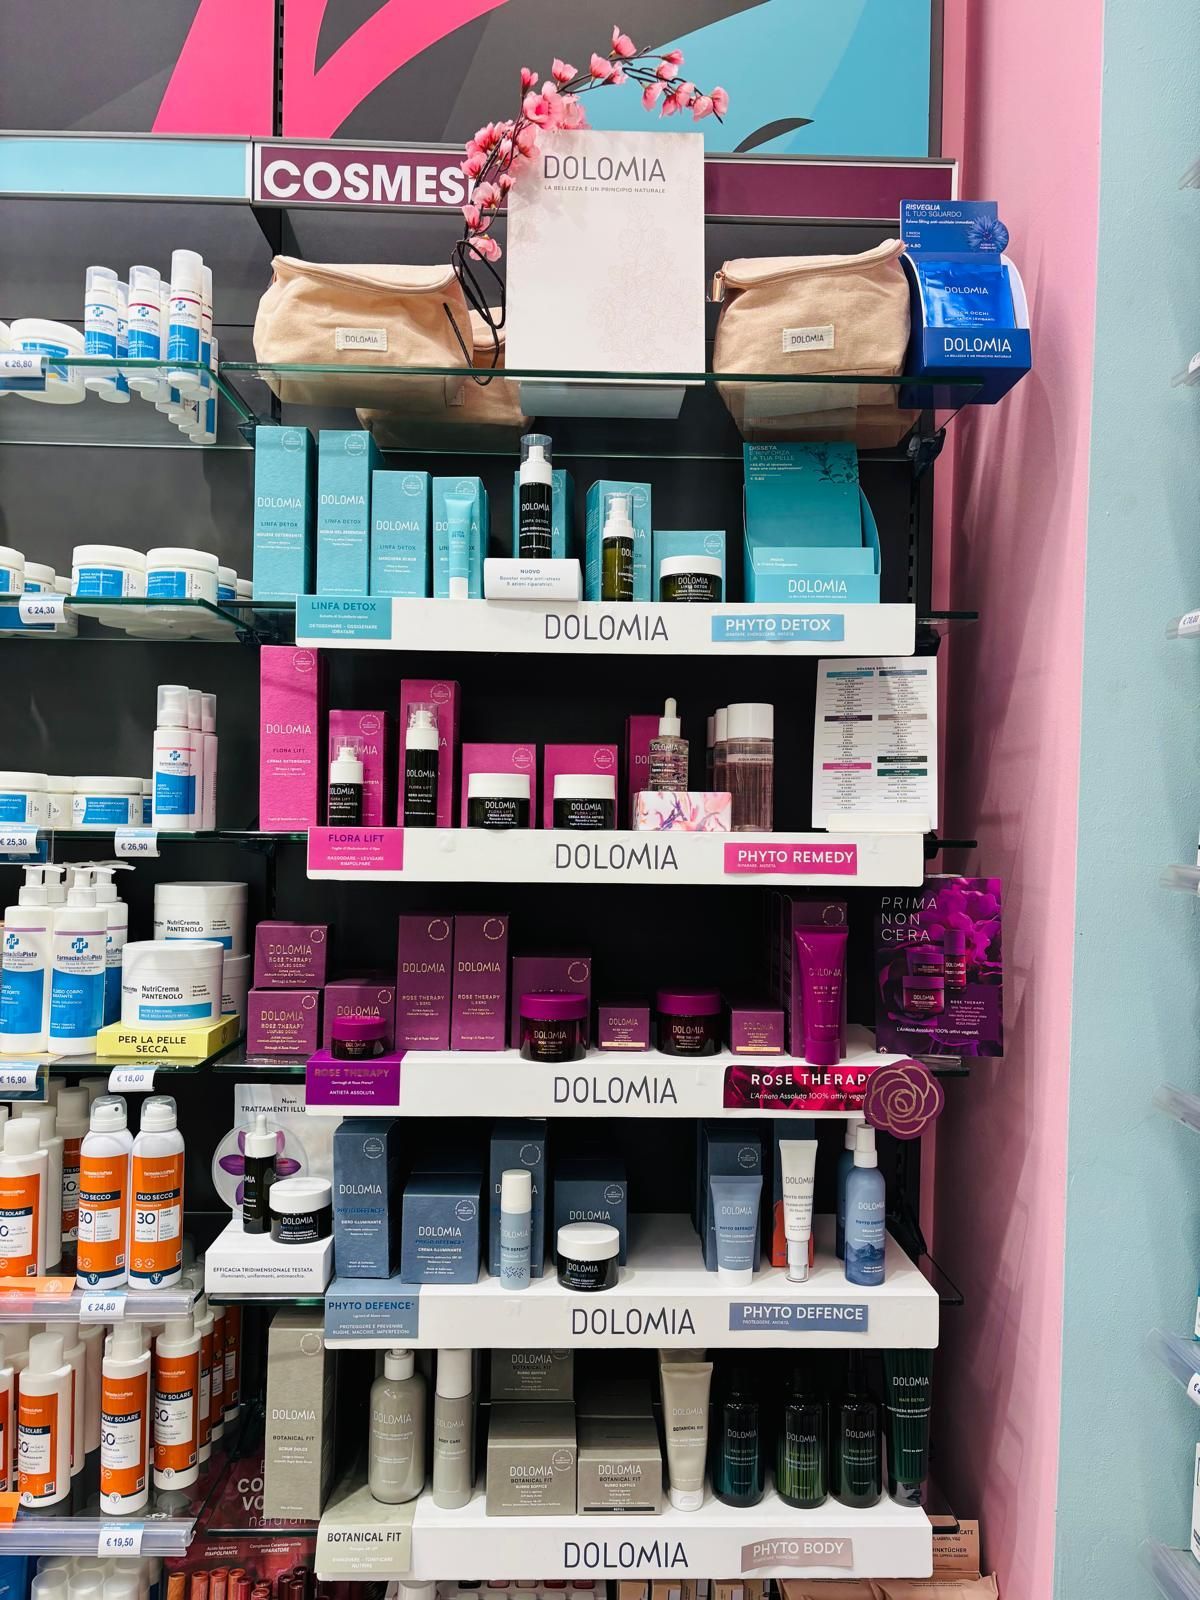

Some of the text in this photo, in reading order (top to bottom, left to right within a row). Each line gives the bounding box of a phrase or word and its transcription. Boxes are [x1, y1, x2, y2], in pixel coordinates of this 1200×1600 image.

[544, 155, 666, 182] DOLOMIA
[905, 203, 941, 211] RISVEGLIA
[944, 286, 989, 295] DOLOMIA
[345, 333, 379, 345] DOLOMIA
[791, 334, 825, 344] DOLOMIA
[943, 338, 1012, 352] DOLOMIA
[257, 497, 302, 508] DOLOMIA
[321, 494, 365, 505] DOLOMIA
[521, 502, 550, 512] DOLOMIA
[375, 520, 420, 531] DOLOMIA
[677, 576, 709, 585] DOLOMIA
[788, 579, 848, 593] DOLOMIA
[34, 606, 55, 615] 24,30
[311, 601, 377, 611] LINFA DETOX
[545, 614, 669, 641] DOLOMIA
[725, 618, 831, 632] PHYTO DETOX
[266, 723, 312, 735] DOLOMIA
[406, 769, 436, 778] DOLOMIA
[485, 801, 516, 809] DOLOMIA
[570, 802, 602, 811] DOLOMIA
[6, 838, 28, 847] 25,30
[328, 834, 385, 843] FLORA LIFT
[120, 843, 149, 852] € 26,90
[554, 843, 679, 871] DOLOMIA
[737, 850, 855, 865] PHYTO REMEDY
[880, 896, 938, 910] PRIMA
[880, 913, 920, 926] NON
[880, 928, 932, 942] C'ERA
[268, 944, 313, 955] DOLOMIA
[402, 962, 446, 973] DOLOMIA
[458, 961, 501, 973] DOLOMIA
[141, 985, 180, 993] NutriCrema
[261, 1010, 304, 1021] DOLOMIA
[336, 1005, 380, 1016] DOLOMIA
[608, 1017, 639, 1027] DOLOMIA
[534, 1030, 567, 1039] DOLOMIA
[672, 1025, 704, 1034] DOLOMIA
[118, 1035, 187, 1044] PER LA PELLE
[136, 1045, 169, 1054] SECCA
[124, 1074, 145, 1083] 18,00
[314, 1068, 390, 1078] ROSE THERAPY
[6, 1076, 27, 1085] 16,90
[751, 1072, 871, 1086] ROSE THERAP
[554, 1075, 678, 1104] DOLOMIA
[808, 1092, 829, 1100] 100%
[830, 1092, 848, 1100] attivi
[340, 1184, 382, 1195] DOLOMIA
[137, 1192, 174, 1201] OLIO SECCO
[569, 1210, 611, 1221] DOLOMIA
[721, 1206, 753, 1216] DOLOMIA
[136, 1212, 156, 1225] 30
[282, 1216, 314, 1225] DOLOMIA
[418, 1226, 462, 1237] DOLOMIA
[568, 1262, 599, 1273] DOLOMIA
[88, 1302, 116, 1312] € 24,80
[328, 1301, 362, 1310] PHYTO
[742, 1306, 864, 1321] PHYTO DEFENCE
[572, 1306, 696, 1335] DOLOMIA
[511, 1354, 553, 1364] DOLOMIA
[892, 1376, 930, 1386] DOLOMIA
[168, 1391, 192, 1400] SOLARE
[272, 1409, 316, 1420] DOLOMIA
[373, 1410, 412, 1425] DOLOMIA
[672, 1407, 704, 1417] DOLOMIA
[114, 1413, 139, 1423] SOLARE
[786, 1432, 818, 1443] DOLOMIA
[846, 1428, 876, 1439] DOLOMIA
[510, 1466, 554, 1477] DOLOMIA
[598, 1464, 642, 1475] DOLOMIA
[106, 1538, 134, 1547] € 19,50
[327, 1532, 402, 1542] BOTANICAL FIT
[564, 1540, 689, 1568] DOLOMIA
[752, 1542, 845, 1558] PHYTO BODY
